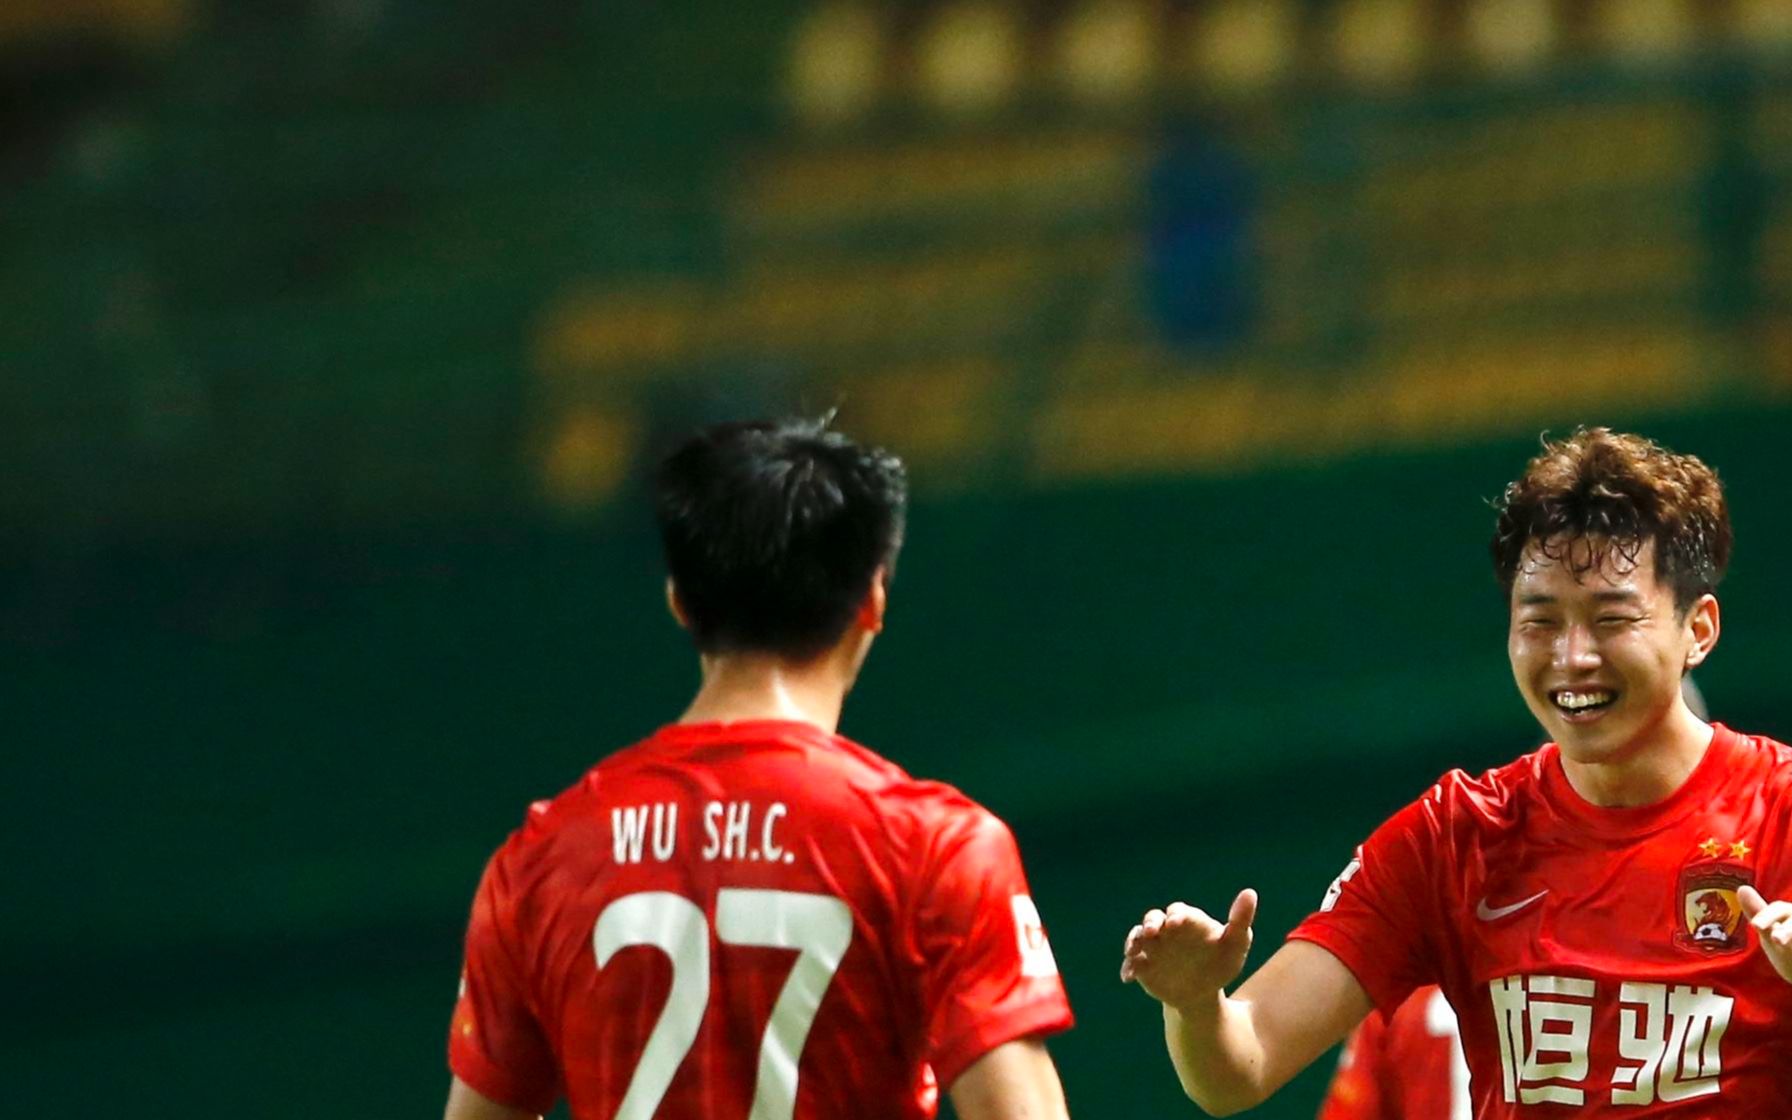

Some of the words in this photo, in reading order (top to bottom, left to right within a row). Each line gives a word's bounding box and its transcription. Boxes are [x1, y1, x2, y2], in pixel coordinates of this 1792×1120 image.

[611, 802, 678, 864] WU
[702, 800, 795, 864] SH.C.
[1489, 975, 1735, 1106] 恒驰
